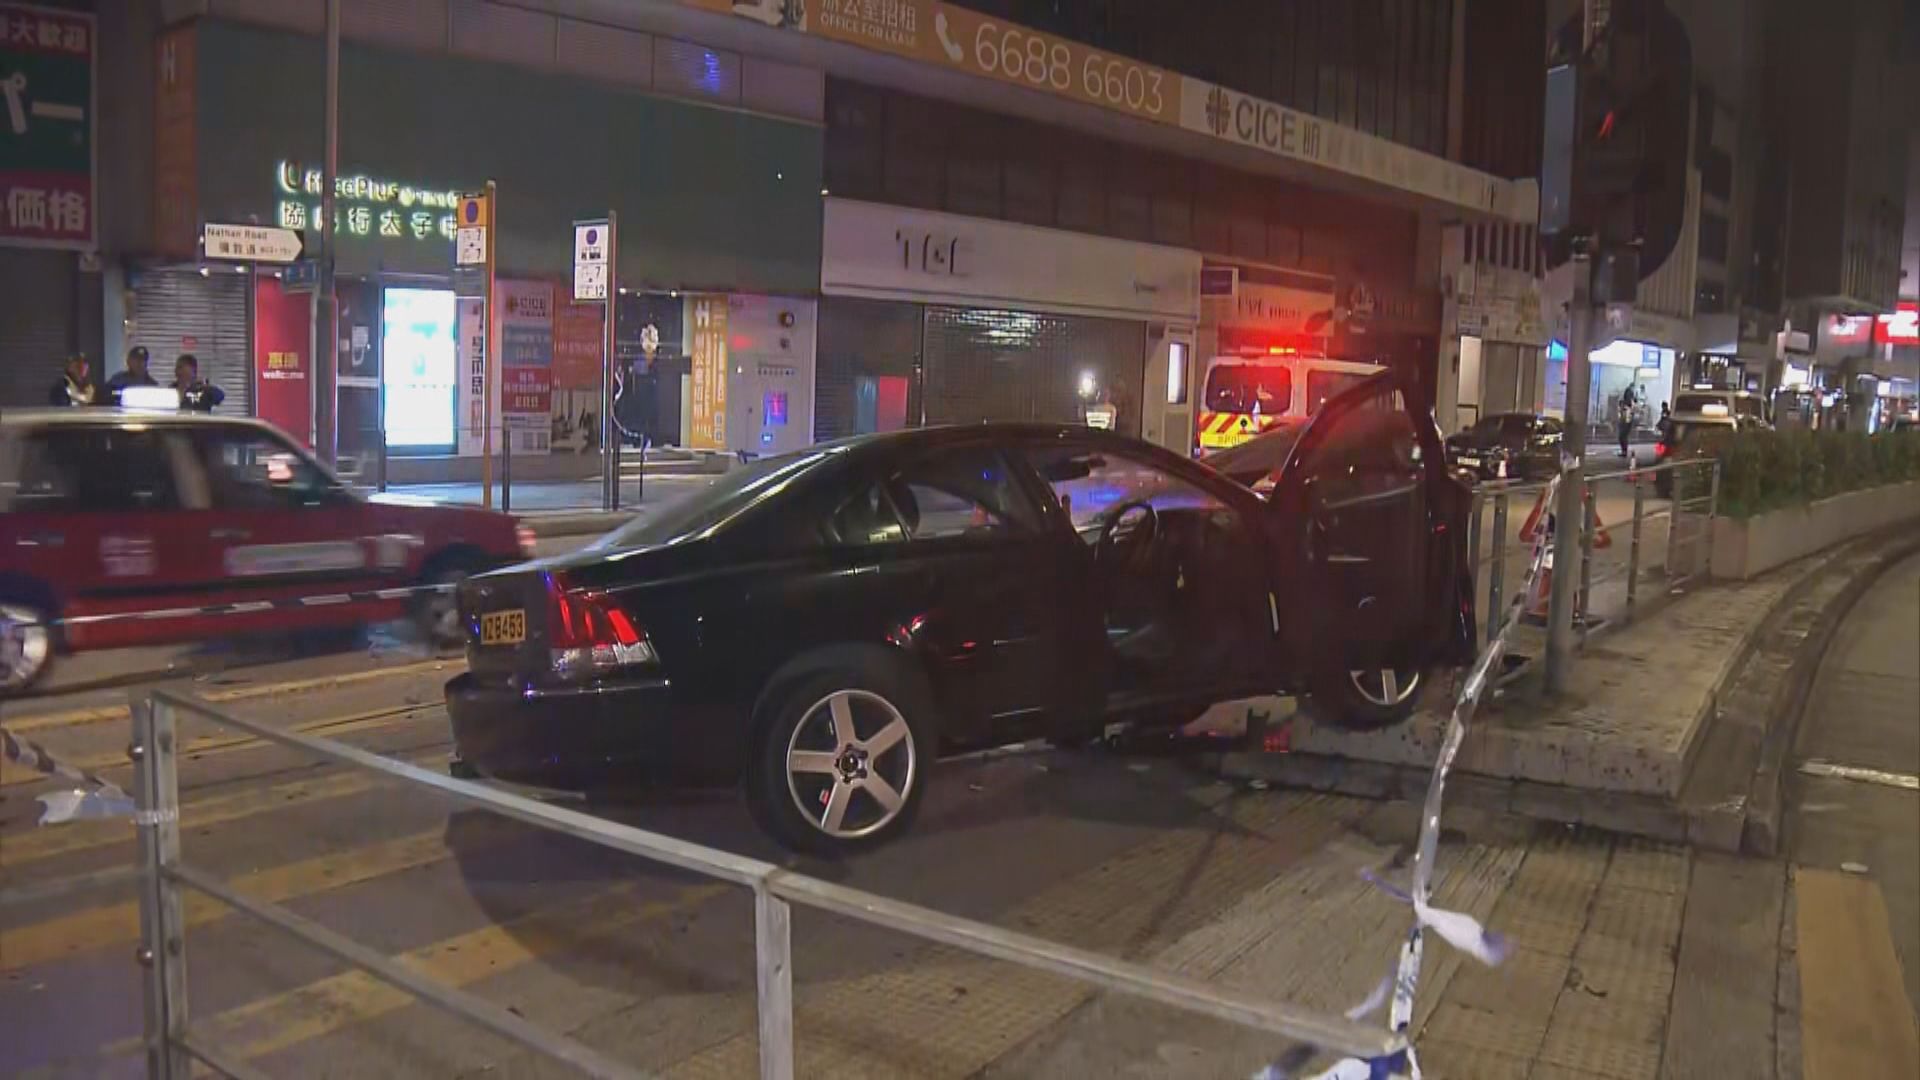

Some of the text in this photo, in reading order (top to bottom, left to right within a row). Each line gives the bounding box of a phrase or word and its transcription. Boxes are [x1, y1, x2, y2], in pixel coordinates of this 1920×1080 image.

[820, 11, 857, 33] OFFICE
[862, 22, 883, 39] FOR
[975, 22, 1163, 114] 6688 6603
[1234, 97, 1297, 151] CICE
[207, 228, 267, 240] Nathan Road
[595, 284, 605, 297] 12
